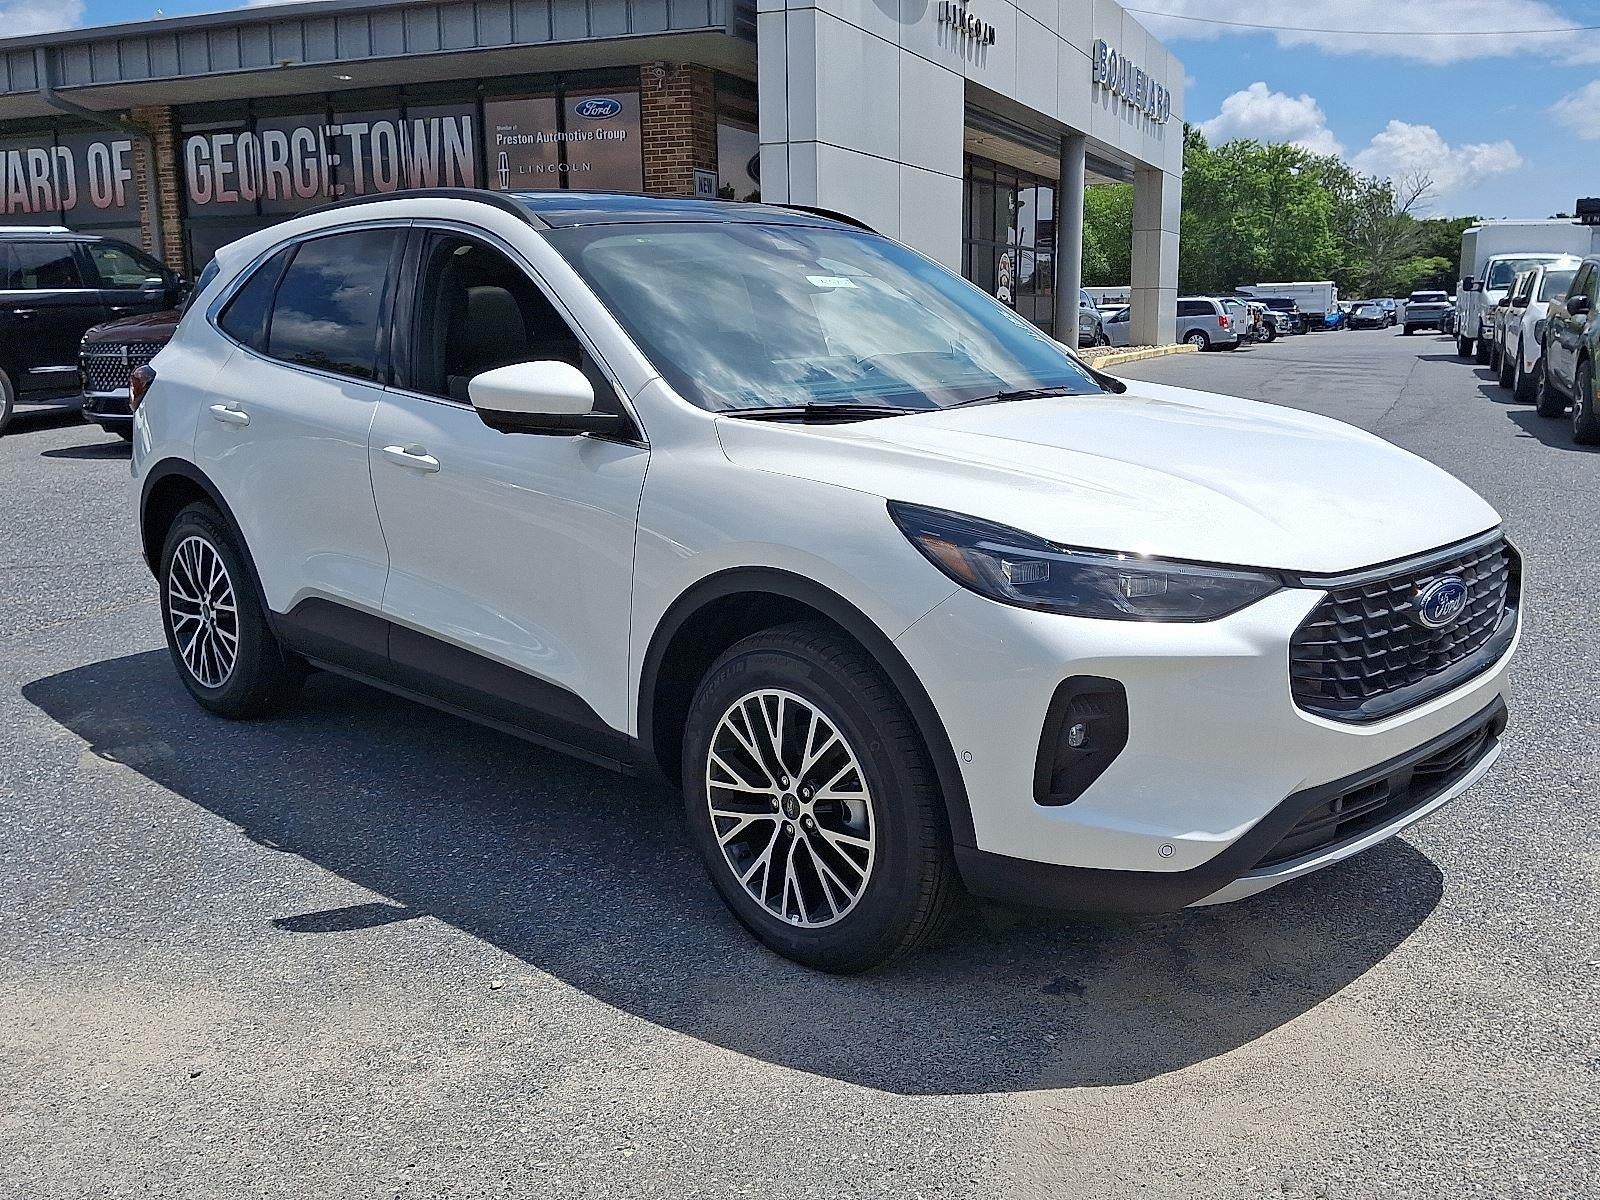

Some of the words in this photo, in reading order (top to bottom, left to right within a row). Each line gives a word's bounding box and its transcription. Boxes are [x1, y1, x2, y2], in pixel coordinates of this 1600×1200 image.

[938, 1, 995, 45] LINCOLN
[1093, 39, 1170, 124] BOULEVARD
[496, 133, 534, 146] Preston
[537, 129, 593, 144] Automotive
[596, 128, 627, 142] Group
[0, 146, 76, 215] ARD
[88, 140, 131, 209] OF
[187, 115, 475, 205] GEORGETOWN
[519, 162, 592, 174] LINCOLN
[698, 177, 713, 193] NEW
